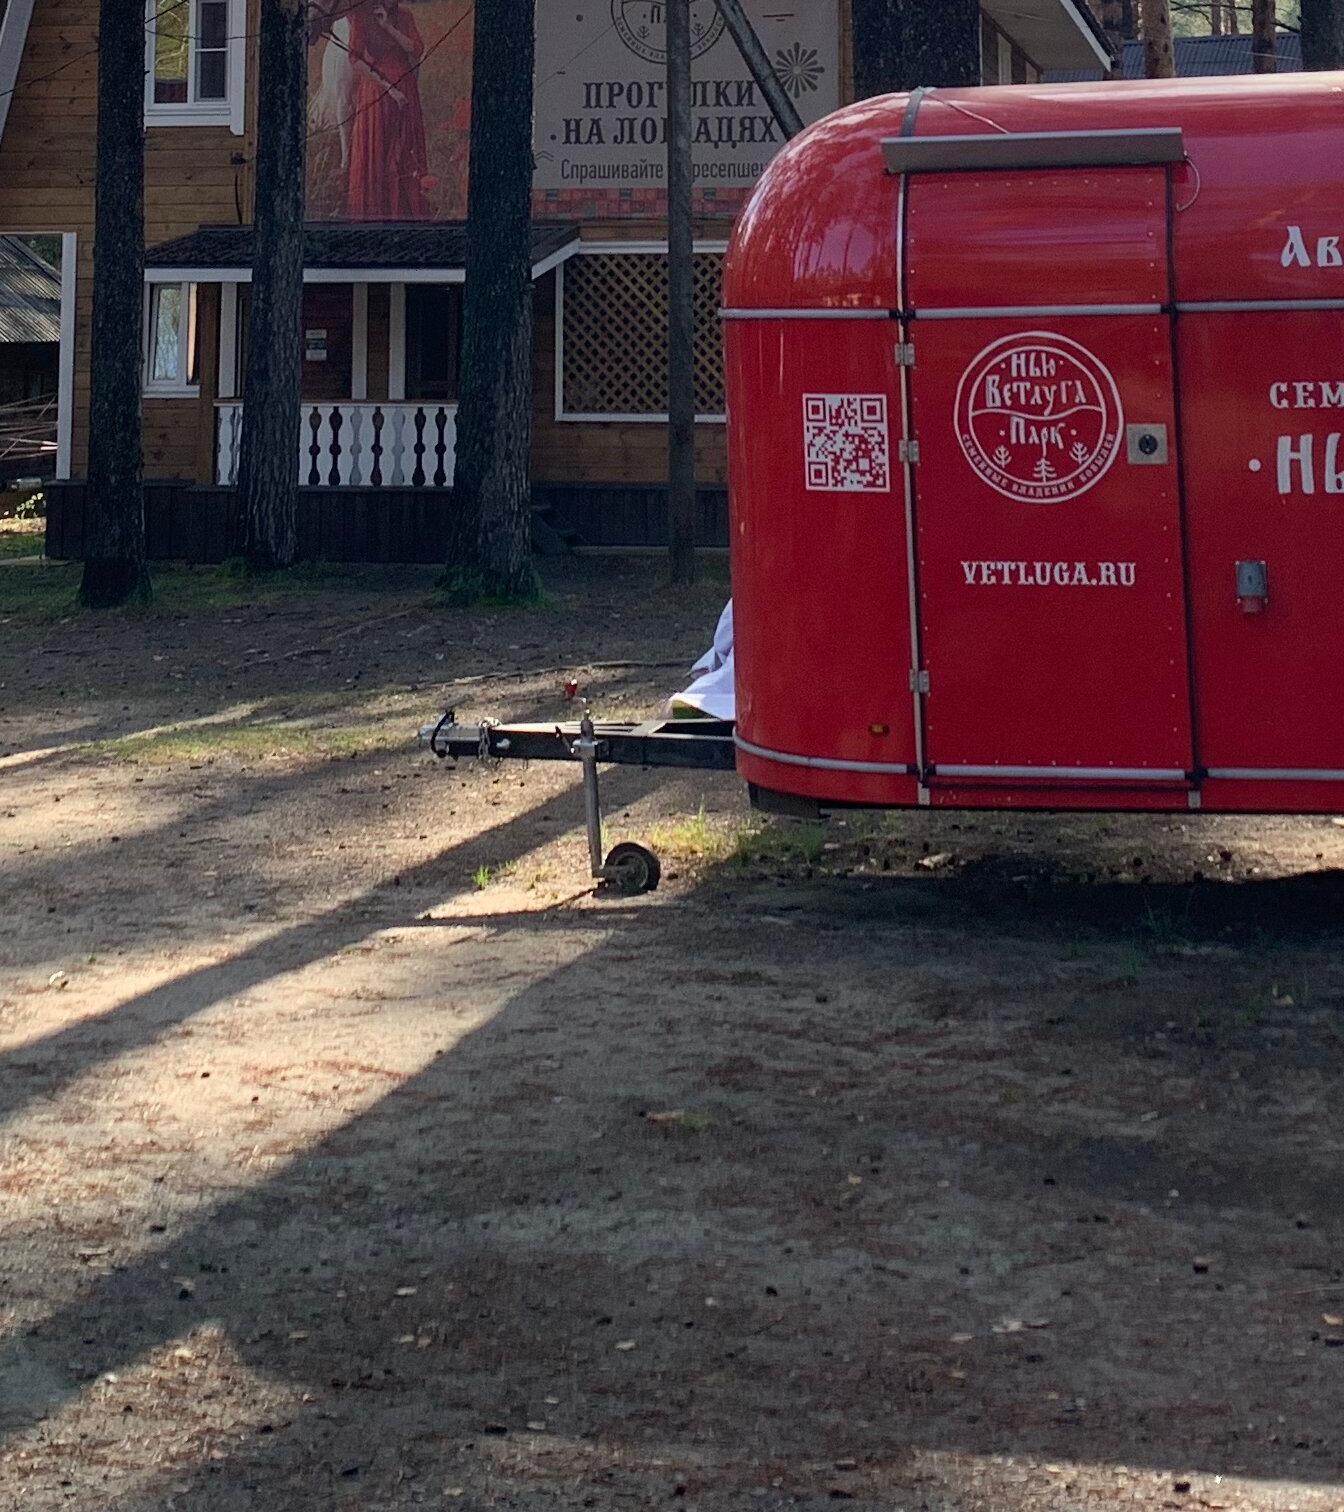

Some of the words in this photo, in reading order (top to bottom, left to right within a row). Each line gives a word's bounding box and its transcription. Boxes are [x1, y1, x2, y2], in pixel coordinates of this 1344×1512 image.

[582, 80, 757, 109] ПРОГЛКИ
[562, 117, 605, 145] НА
[561, 159, 663, 183] Спрашивайте
[1010, 416, 1066, 457] Парк
[961, 560, 1136, 586] VETLUGA.RU
